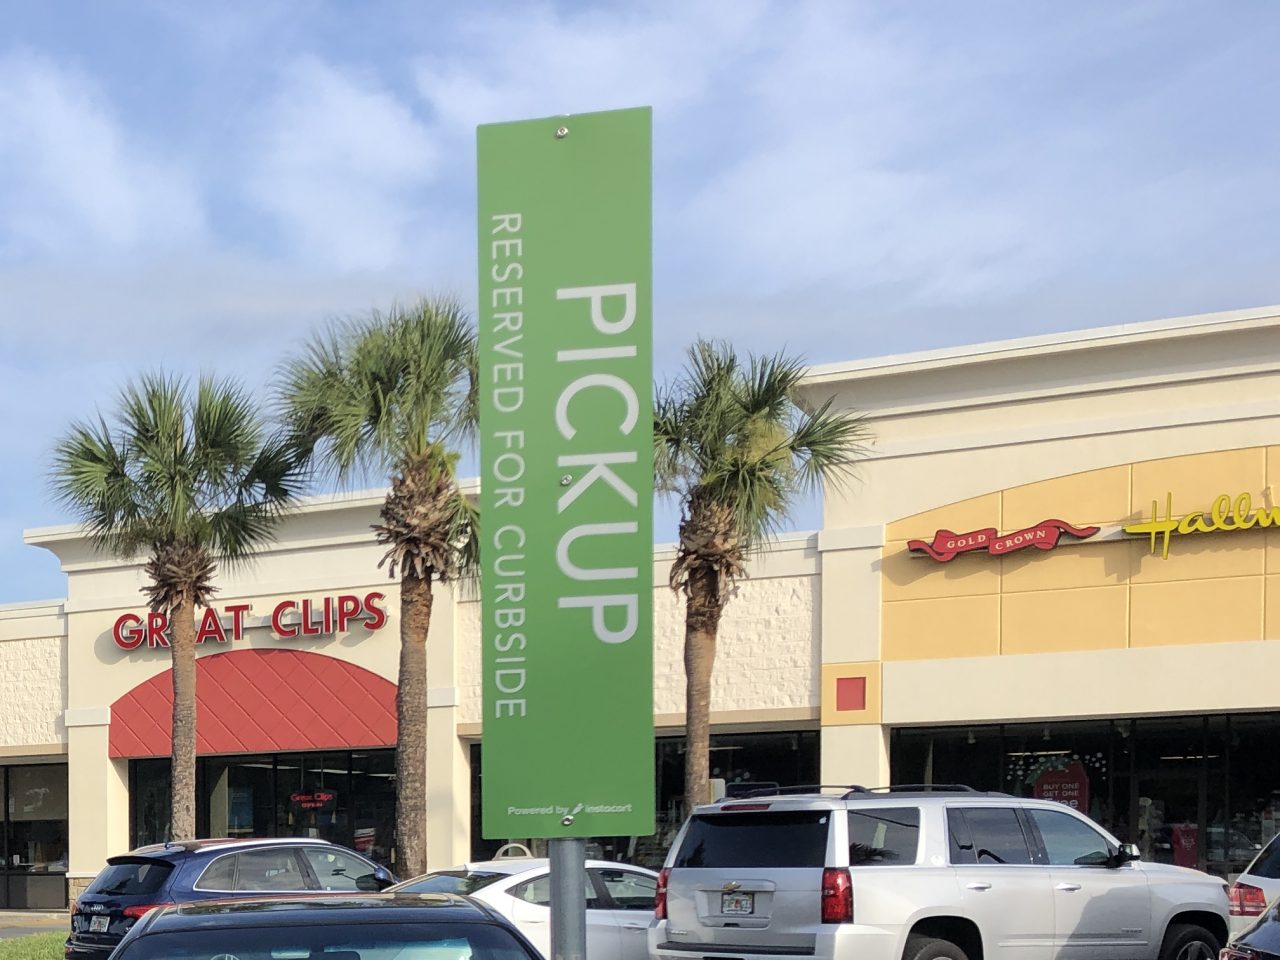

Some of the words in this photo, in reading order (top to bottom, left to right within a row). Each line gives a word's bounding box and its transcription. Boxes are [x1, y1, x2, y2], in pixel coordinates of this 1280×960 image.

[491, 213, 524, 412] RESERVED
[493, 431, 525, 508] FOR
[555, 283, 639, 644] PICKUP
[946, 534, 987, 548] GOLD
[995, 530, 1046, 550] CROWN
[113, 604, 251, 650] GRAT
[271, 591, 388, 638] CLIPS
[493, 525, 526, 718] CURBSIDE
[508, 806, 554, 815] Powered
[556, 806, 569, 815] by
